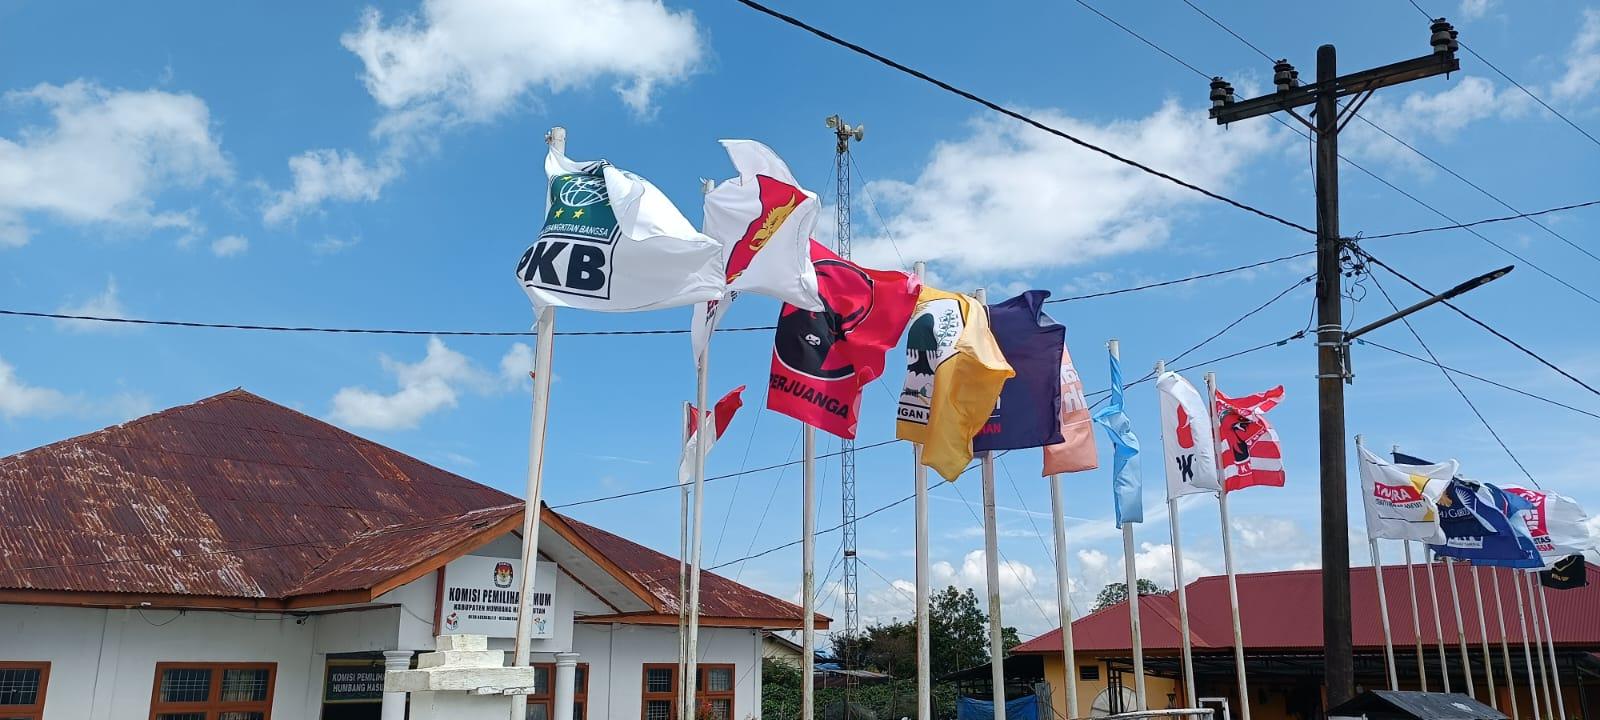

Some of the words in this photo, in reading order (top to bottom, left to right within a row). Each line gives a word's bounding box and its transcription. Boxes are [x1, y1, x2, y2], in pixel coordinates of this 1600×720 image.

[578, 225, 609, 237] BANGSA
[516, 241, 606, 291] PKB
[449, 588, 481, 603] KOMISI
[483, 590, 520, 604] PEMILIHA
[533, 593, 552, 606] MUM
[332, 673, 356, 682] KOMISI
[333, 684, 366, 692] HUMBANG
